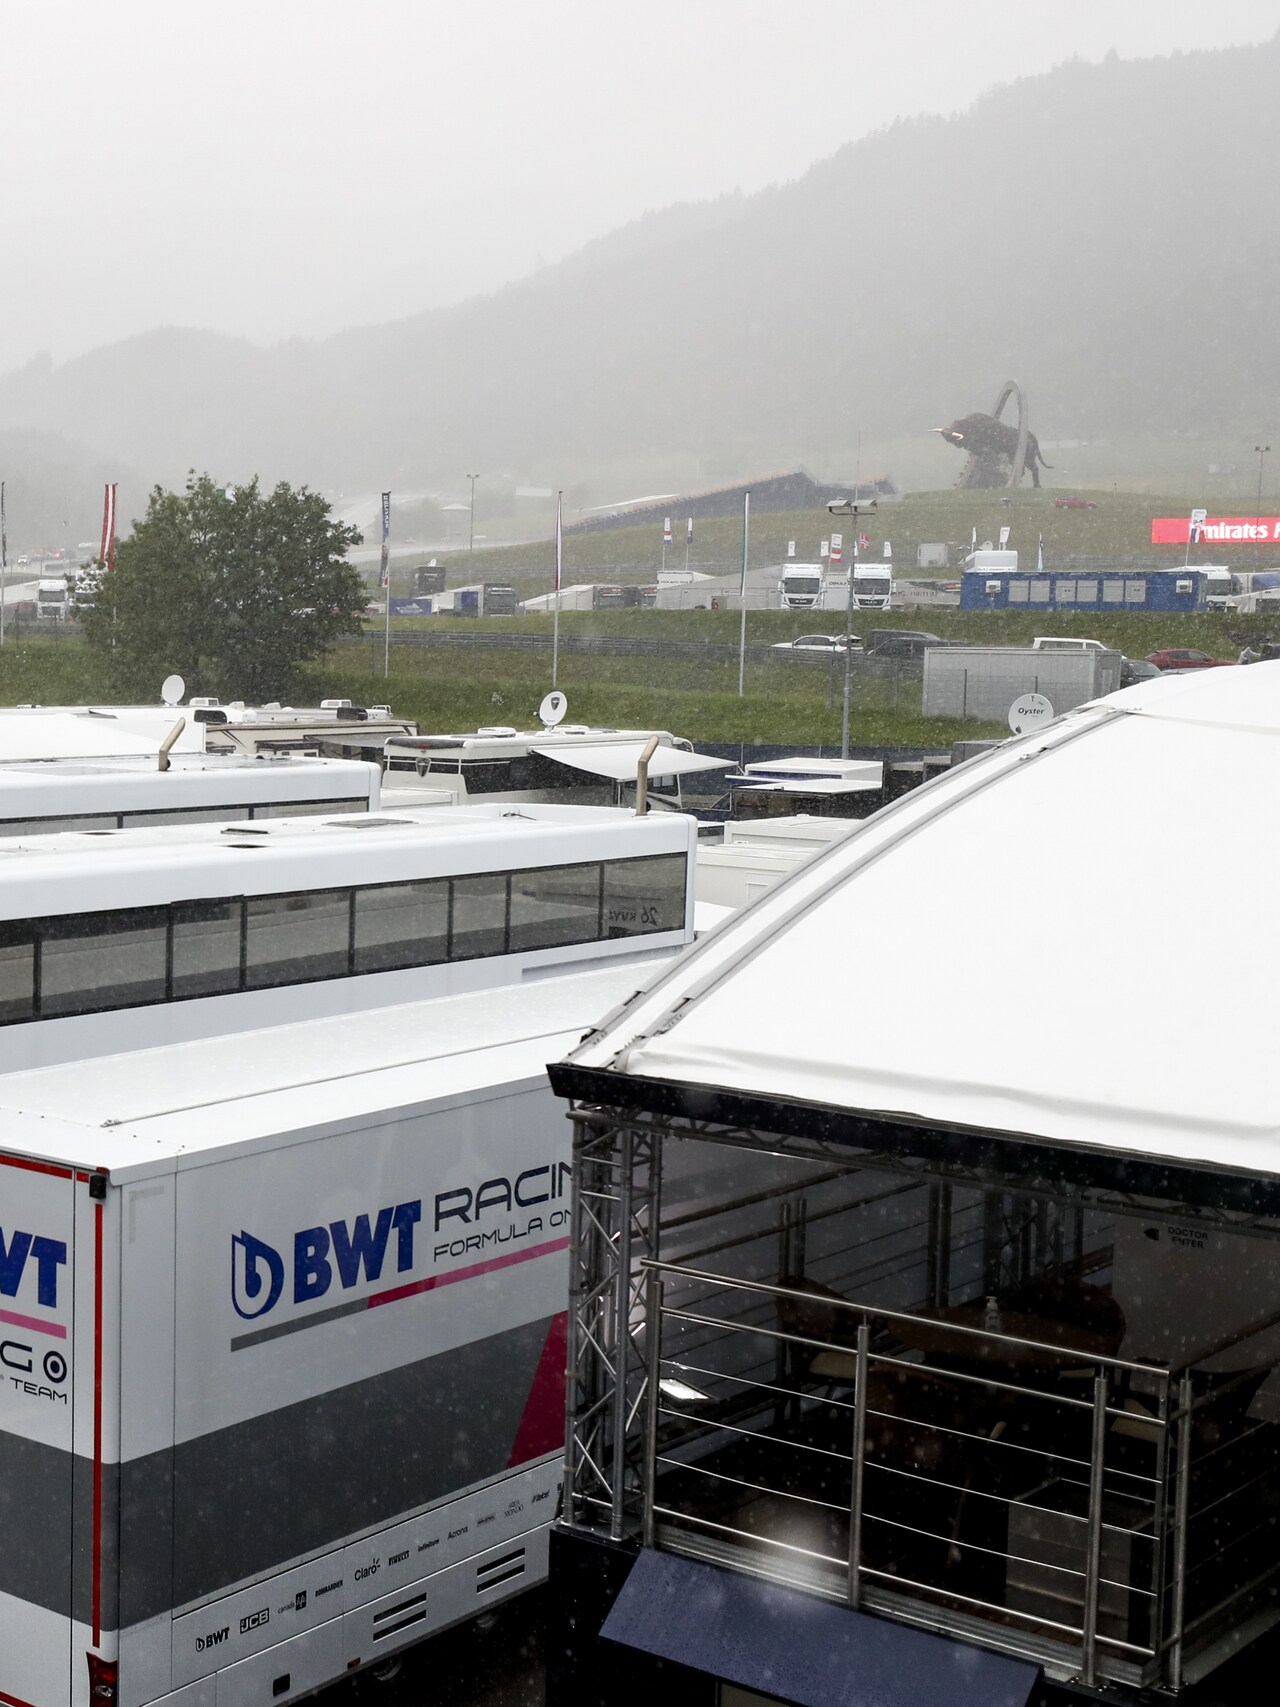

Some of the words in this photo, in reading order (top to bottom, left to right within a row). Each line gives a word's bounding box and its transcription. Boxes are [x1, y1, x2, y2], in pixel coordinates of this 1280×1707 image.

[1189, 522, 1268, 539] mirates
[1018, 707, 1045, 716] Oyster
[434, 1216, 542, 1263] FORMULA
[1168, 1227, 1208, 1240] DOCTOR
[1172, 1236, 1204, 1248] ENTER
[294, 1199, 422, 1305] BWT
[10, 1377, 67, 1405] TEAM
[207, 1627, 230, 1648] BWT
[241, 1610, 269, 1633] JCB
[354, 1564, 377, 1581] Claro
